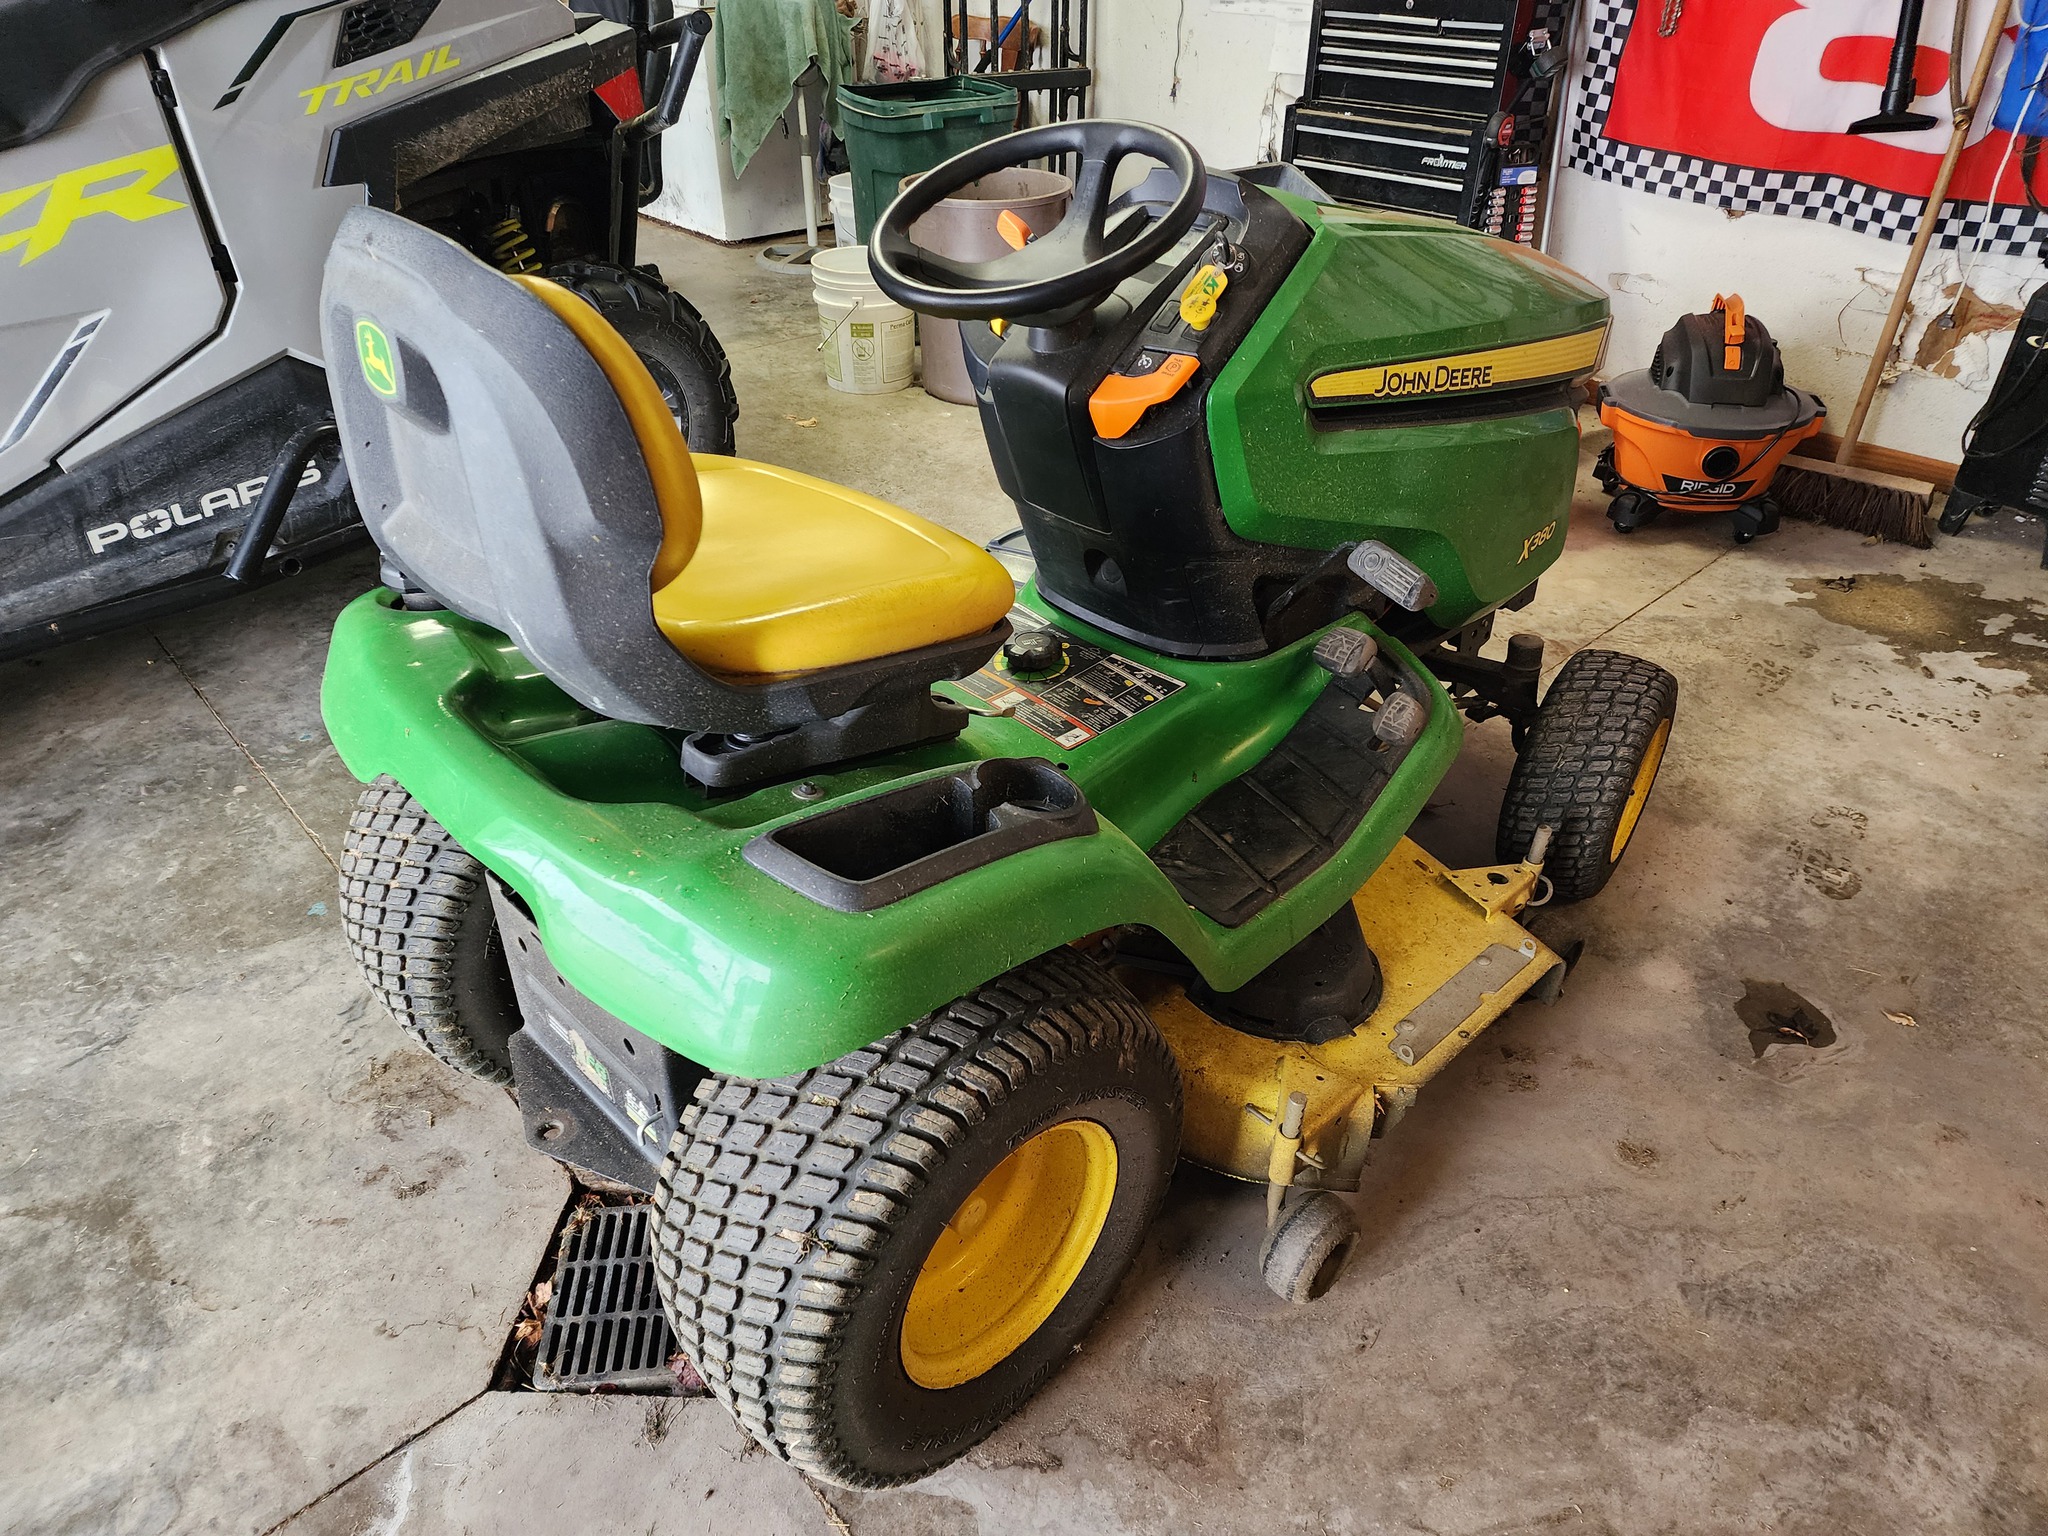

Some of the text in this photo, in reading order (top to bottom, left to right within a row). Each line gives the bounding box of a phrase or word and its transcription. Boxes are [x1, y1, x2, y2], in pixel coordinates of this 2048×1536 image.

[298, 44, 461, 116] TRAIL
[1421, 153, 1468, 171] FRONTIER
[1374, 365, 1494, 396] JOHN DEERE
[86, 459, 322, 555] POLARS
[1517, 520, 1556, 565] X380
